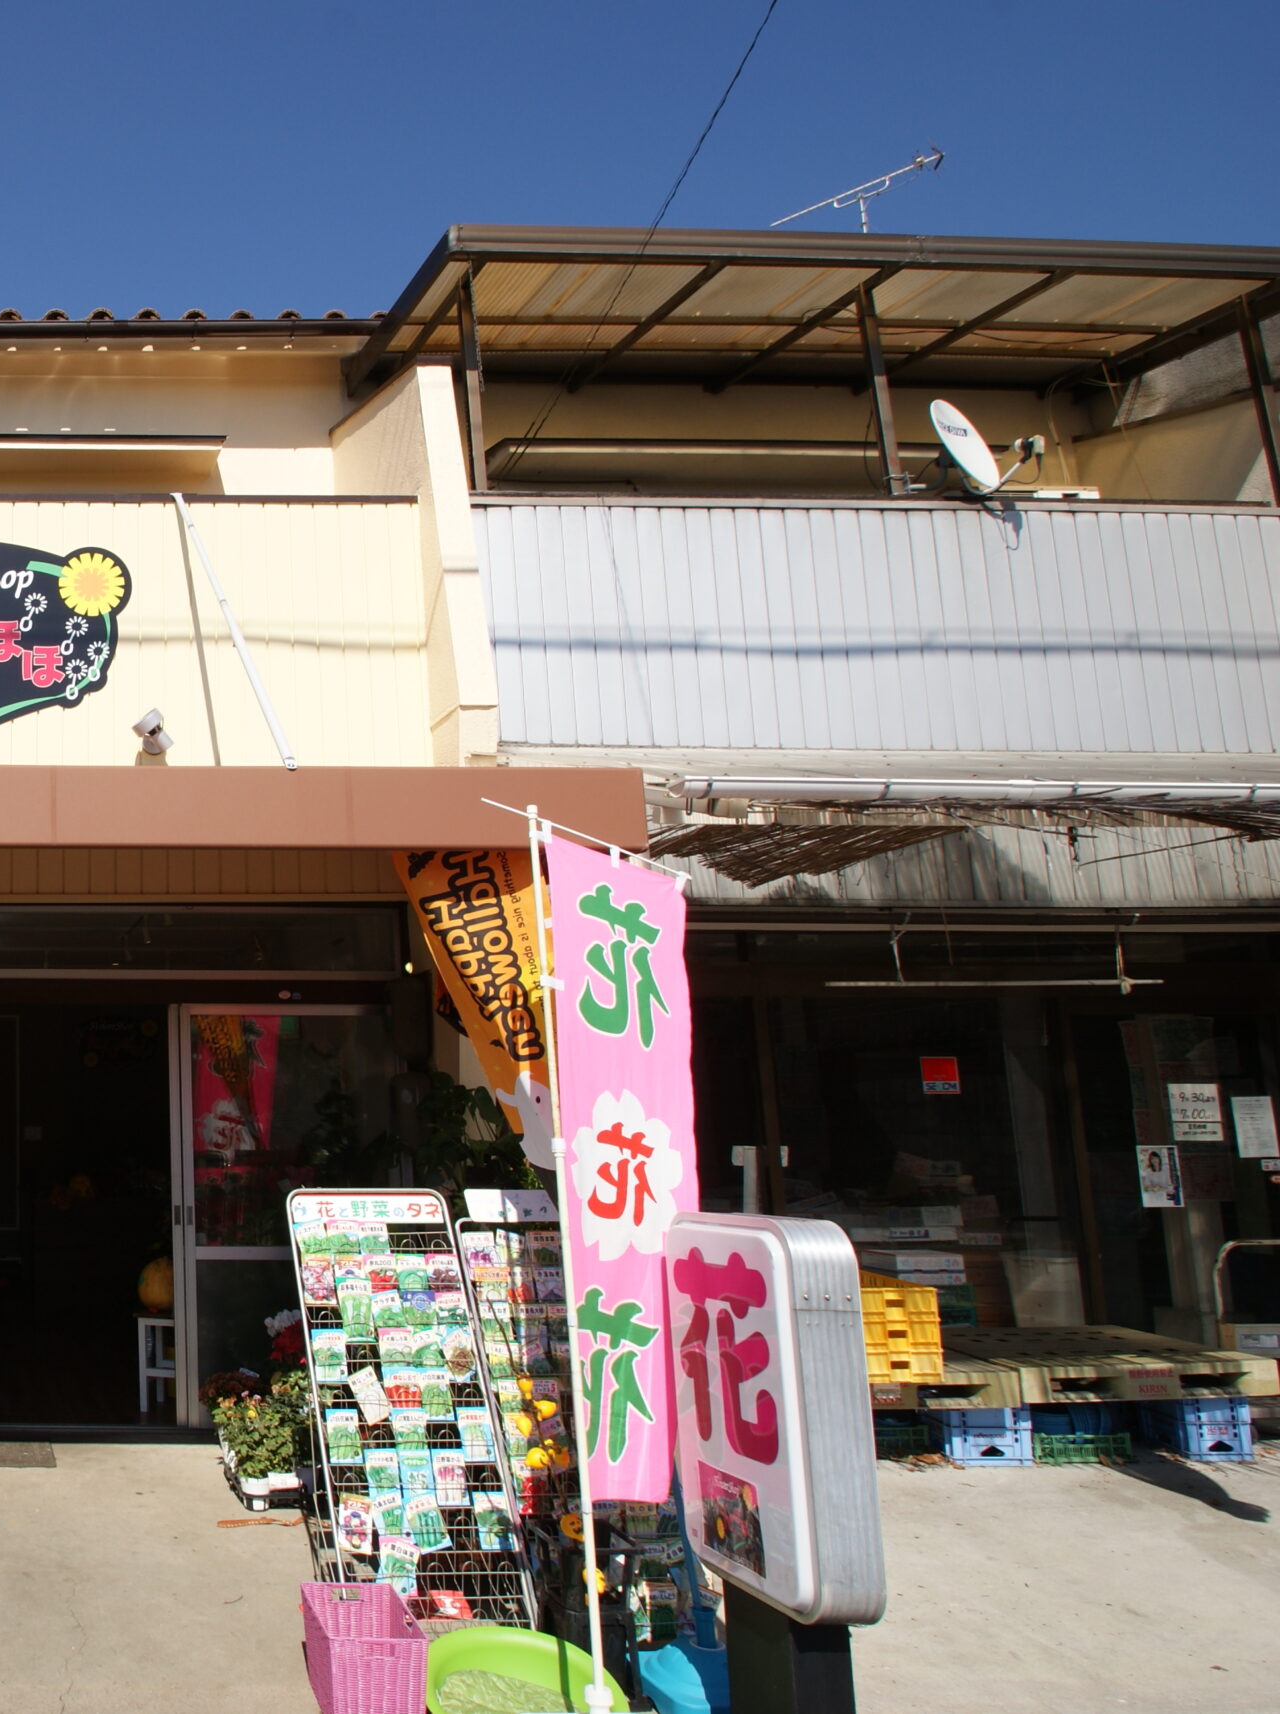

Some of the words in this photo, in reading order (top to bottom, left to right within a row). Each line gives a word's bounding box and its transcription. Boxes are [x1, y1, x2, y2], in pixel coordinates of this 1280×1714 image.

[926, 1082, 958, 1091] SEOM
[316, 1199, 441, 1219] 花と野菜のタネ
[672, 1246, 781, 1466] 花
[1139, 1384, 1168, 1393] KIRIN
